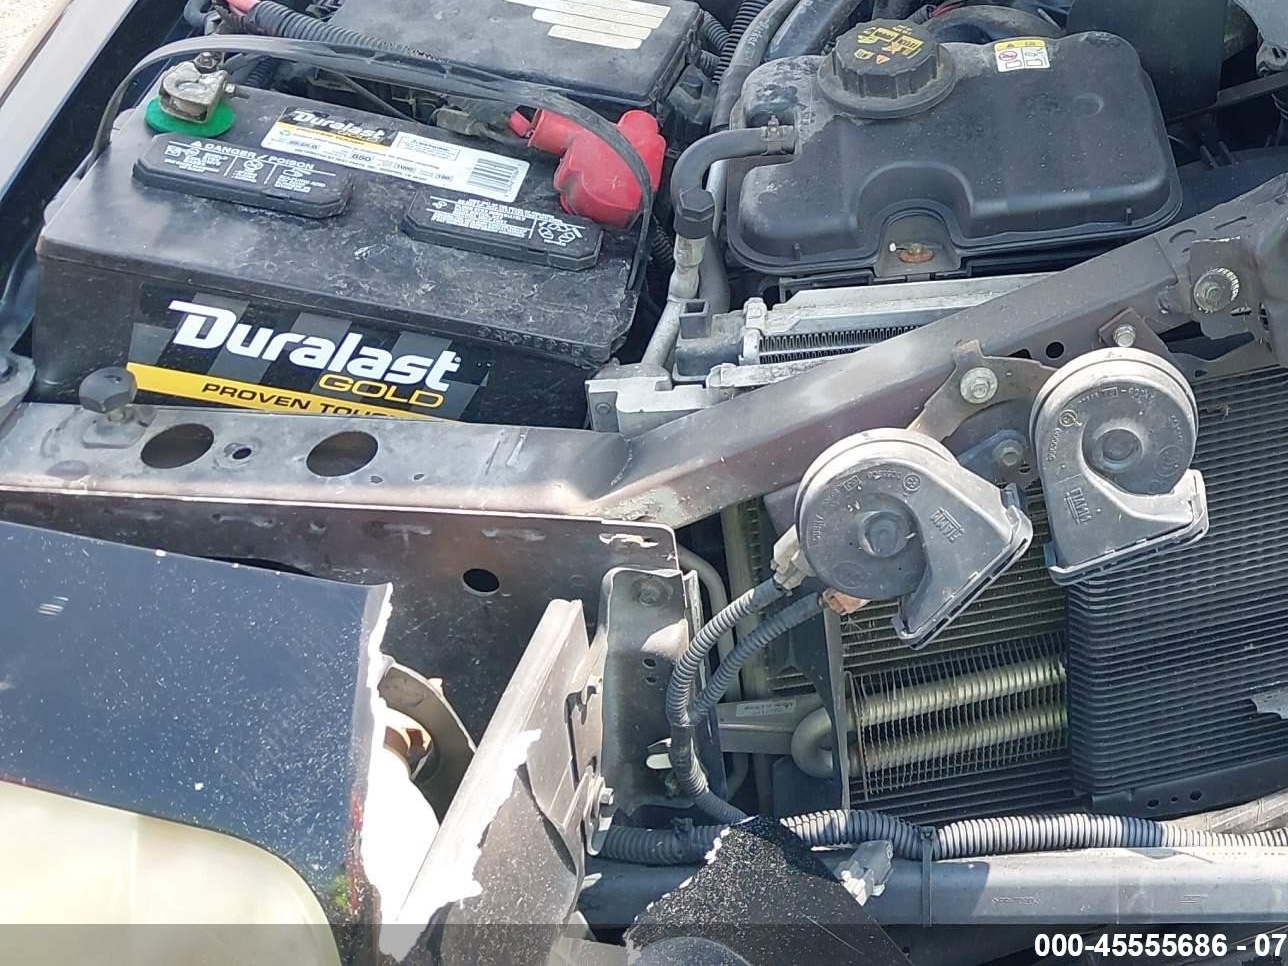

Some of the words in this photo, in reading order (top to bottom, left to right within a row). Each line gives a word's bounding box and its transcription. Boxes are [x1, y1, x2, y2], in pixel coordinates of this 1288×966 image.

[293, 110, 387, 140] Duralast
[204, 143, 257, 159] DANGER
[268, 155, 315, 170] POISON
[168, 299, 460, 392] Duralast
[201, 383, 311, 411] PROVEN
[318, 373, 445, 408] GOLD
